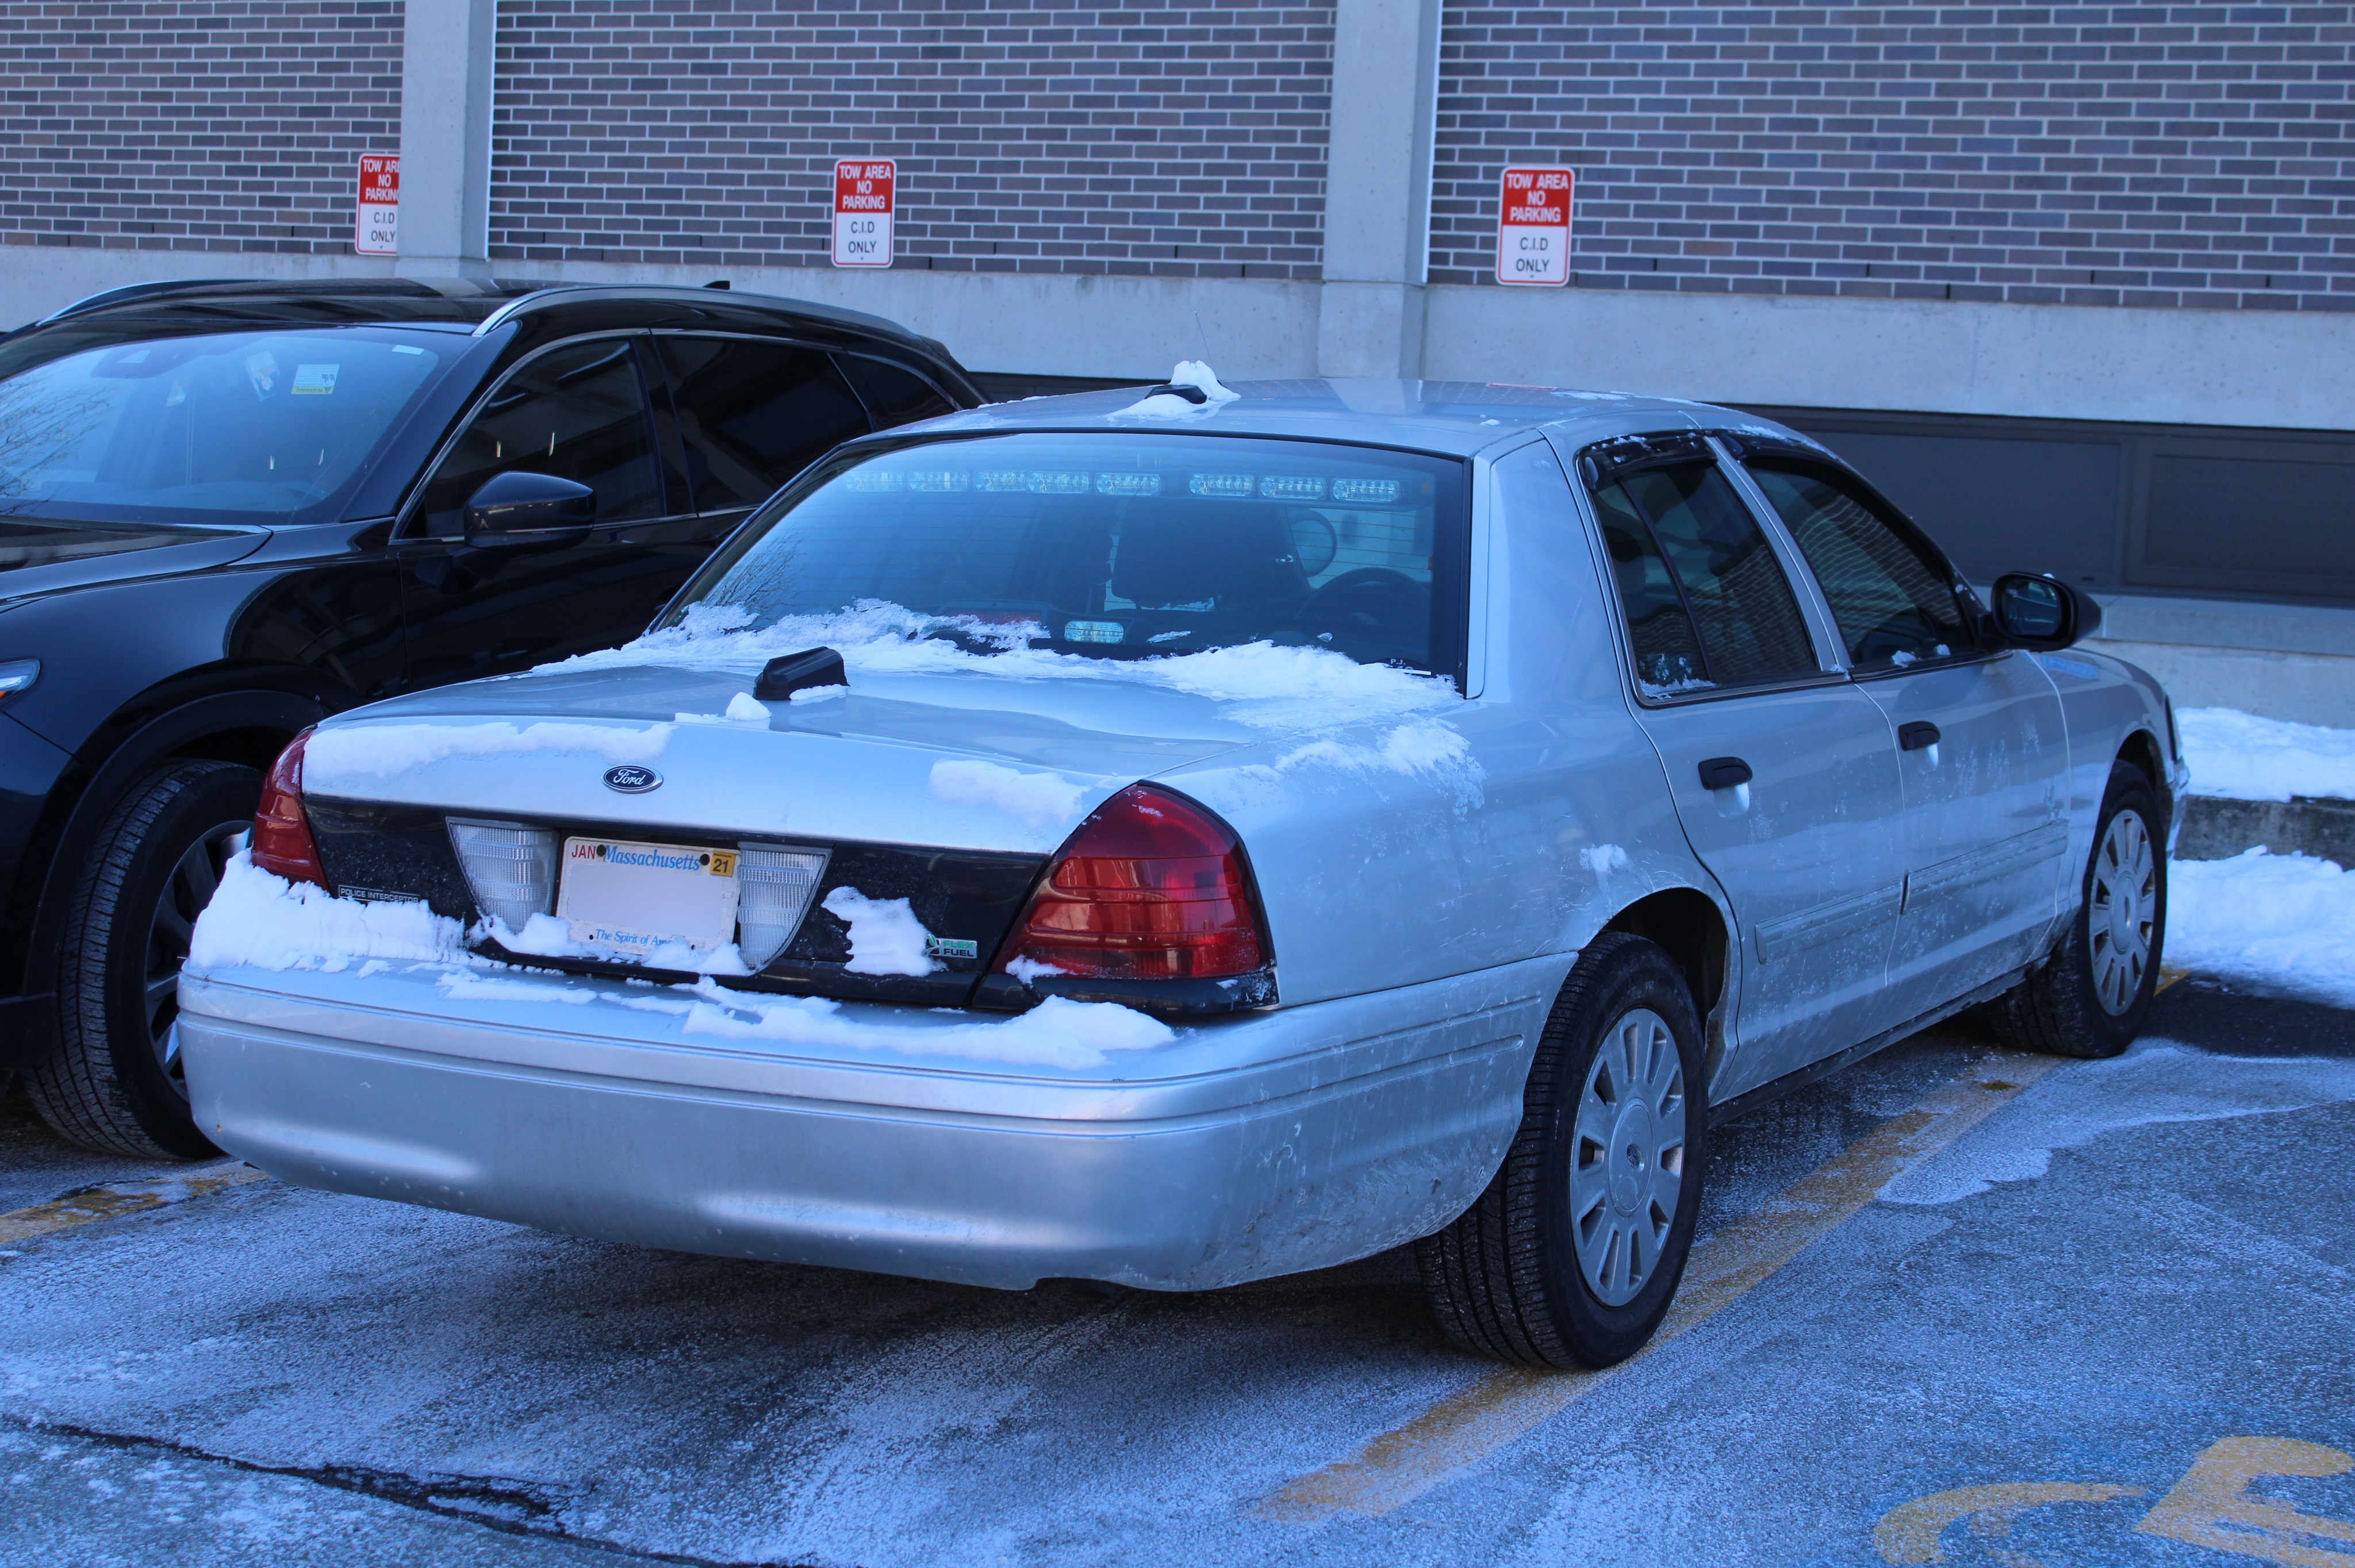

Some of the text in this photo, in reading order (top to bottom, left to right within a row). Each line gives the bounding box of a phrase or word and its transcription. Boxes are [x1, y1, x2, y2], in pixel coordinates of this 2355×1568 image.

[363, 159, 400, 173] TOW ARE
[839, 164, 891, 179] TOW AREA
[378, 173, 392, 187] NO
[857, 180, 872, 194] NO
[1506, 174, 1568, 190] TOW AREA
[842, 195, 885, 210] PARKING
[1527, 190, 1546, 206] NO
[374, 212, 395, 224] C.I.D
[1510, 207, 1561, 222] PARKING
[851, 221, 875, 233] C.I.D
[371, 230, 396, 243] ONLY
[848, 241, 876, 253] ONLY
[1520, 237, 1548, 251] C.I.D
[1516, 259, 1549, 272] ONLY
[613, 768, 647, 785] Ford
[572, 844, 728, 873] JAN Massachusetts 21
[340, 888, 419, 904] POLICE INTERCEPTOR
[596, 929, 612, 940] The
[615, 931, 638, 944] Spirit
[640, 935, 650, 947] of
[943, 940, 974, 949] FLEX
[943, 948, 974, 957] FUEL
